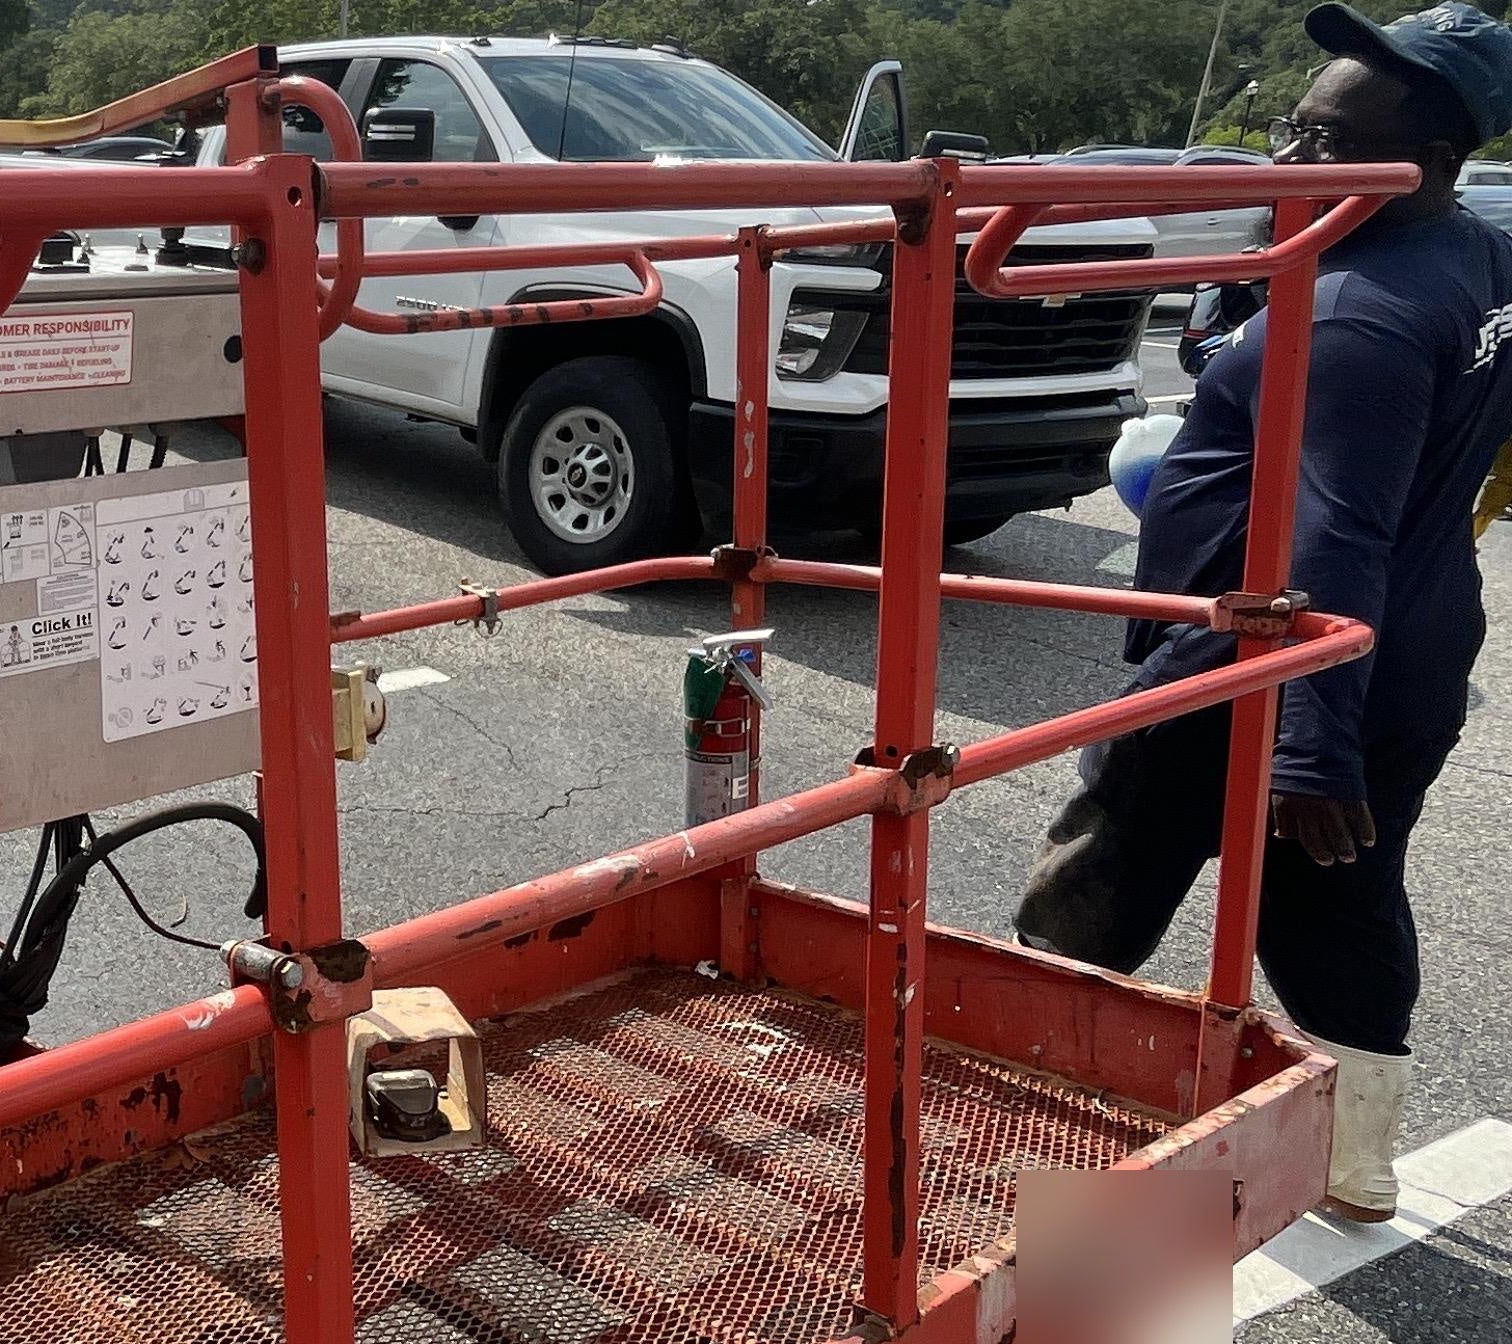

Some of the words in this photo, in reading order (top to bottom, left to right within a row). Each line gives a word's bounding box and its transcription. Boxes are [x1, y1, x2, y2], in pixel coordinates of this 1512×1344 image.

[395, 295, 438, 312] 2500
[33, 318, 130, 336] RESPONSIBILITY
[31, 616, 71, 635] Click
[76, 612, 92, 627] It!
